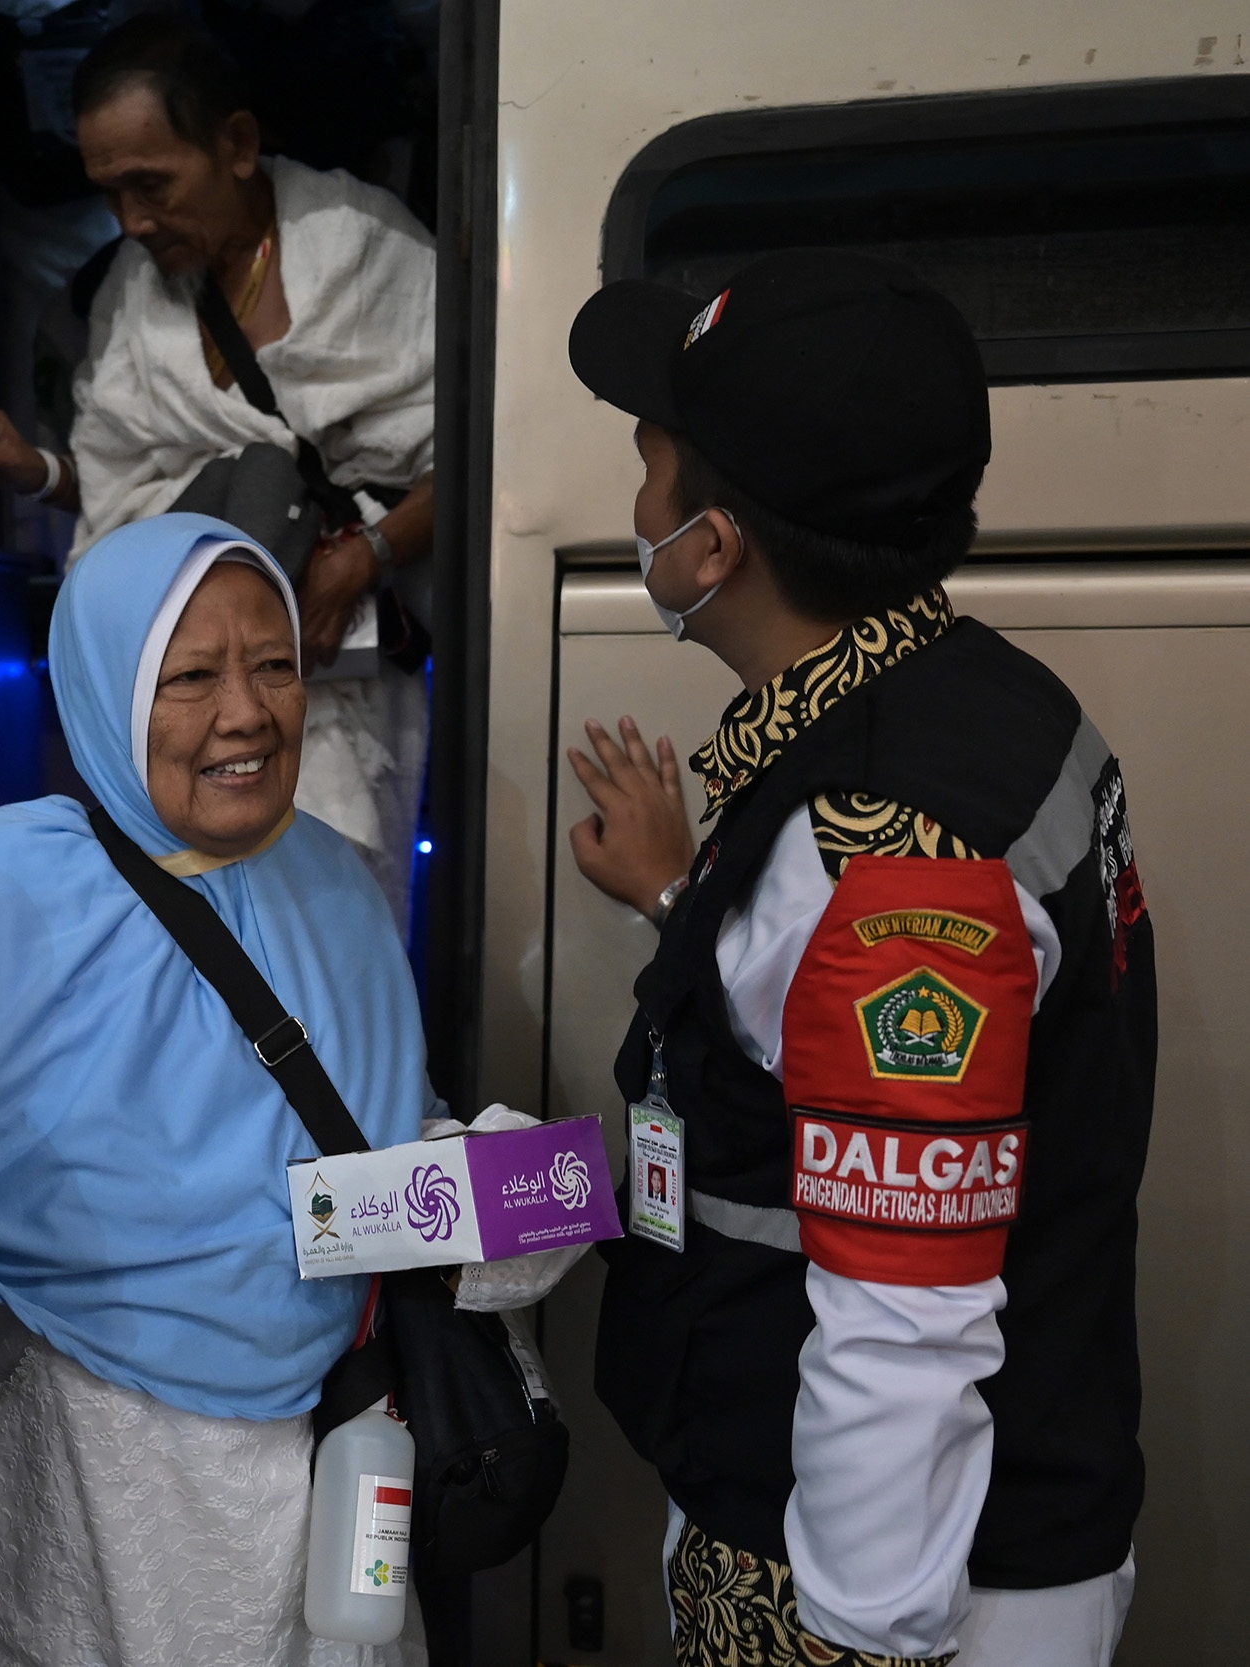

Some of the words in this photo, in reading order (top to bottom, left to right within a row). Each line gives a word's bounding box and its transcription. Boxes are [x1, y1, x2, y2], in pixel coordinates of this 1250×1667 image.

[860, 916, 942, 941] KEMENTERIAN
[942, 920, 985, 950] AGAMA
[802, 1122, 1020, 1191] DALGAS
[502, 1171, 546, 1196] الوكلاء
[350, 1190, 399, 1220] الوكلاء
[503, 1199, 514, 1209] AL
[514, 1194, 549, 1207] WUKALLA
[796, 1172, 871, 1217] PENGENDALI
[872, 1187, 937, 1223] PETUGAS
[939, 1193, 970, 1225] HAJI
[970, 1186, 1017, 1223] INDONESIA
[352, 1226, 362, 1237] AL
[362, 1221, 402, 1236] WUKALLA
[365, 1533, 394, 1541] REPUBLIK
